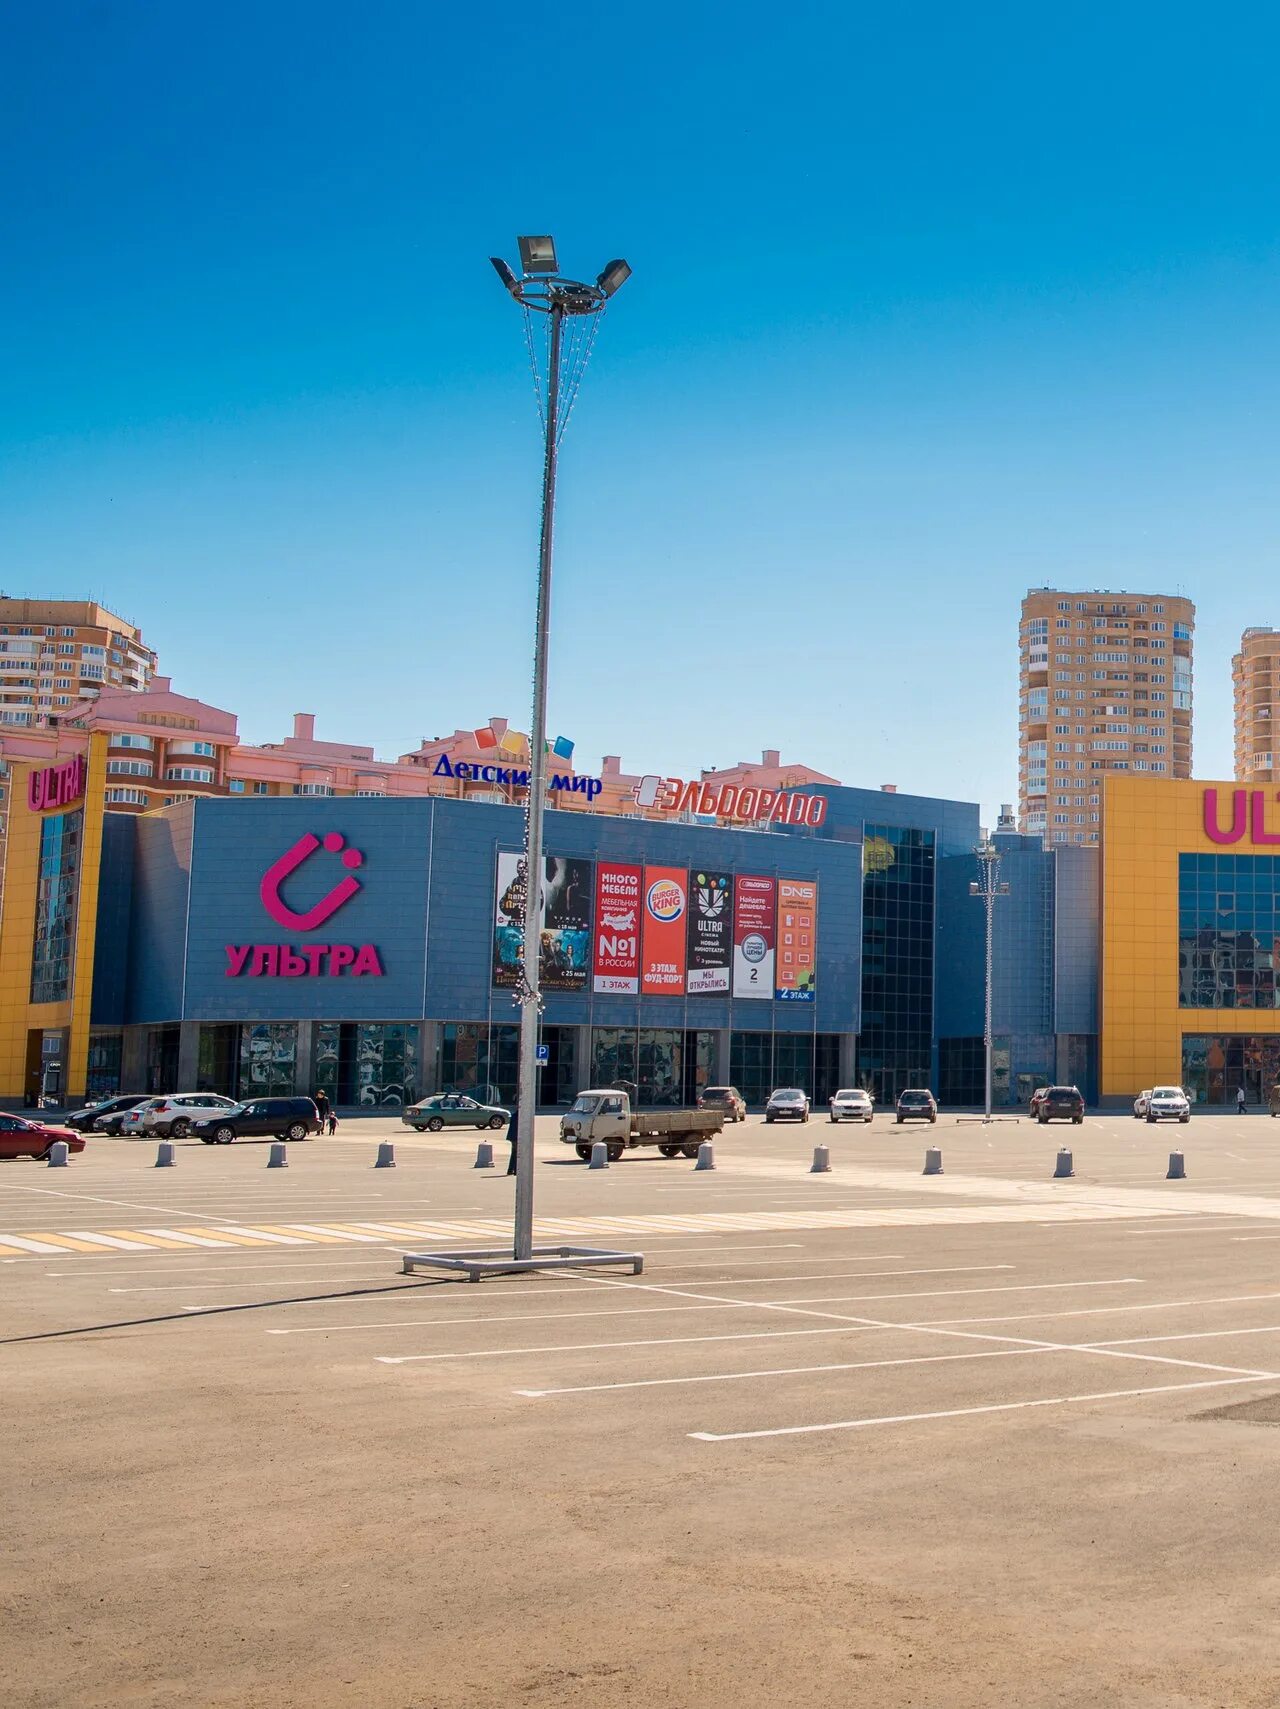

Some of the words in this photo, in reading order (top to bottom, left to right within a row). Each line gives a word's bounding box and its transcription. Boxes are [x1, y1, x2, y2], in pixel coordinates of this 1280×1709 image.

[28, 754, 84, 811] ULTRA
[550, 774, 603, 801] мир
[601, 873, 638, 884] МНОГО
[601, 884, 638, 895] МЕБЕЛИ
[652, 888, 680, 902] BURGER
[781, 886, 813, 898] DNS
[601, 898, 638, 907] МЕБЕЛЬНАЯ
[653, 896, 681, 912] KING
[698, 920, 723, 933] ULTRA
[224, 944, 383, 978] УЛЬТРА
[599, 958, 604, 966] В
[605, 958, 635, 968] РОССИИ
[651, 963, 656, 972] 3
[656, 963, 677, 973] ЭТАЖ
[750, 968, 758, 980] 2
[644, 973, 683, 984] ФУД-КОРТ
[702, 970, 714, 980] МЫ
[609, 981, 630, 989] ЭТАЖ
[689, 978, 727, 990] ОТКРЫЛИСЬ
[781, 987, 788, 999] 2
[790, 991, 810, 999] ЭТАЖ
